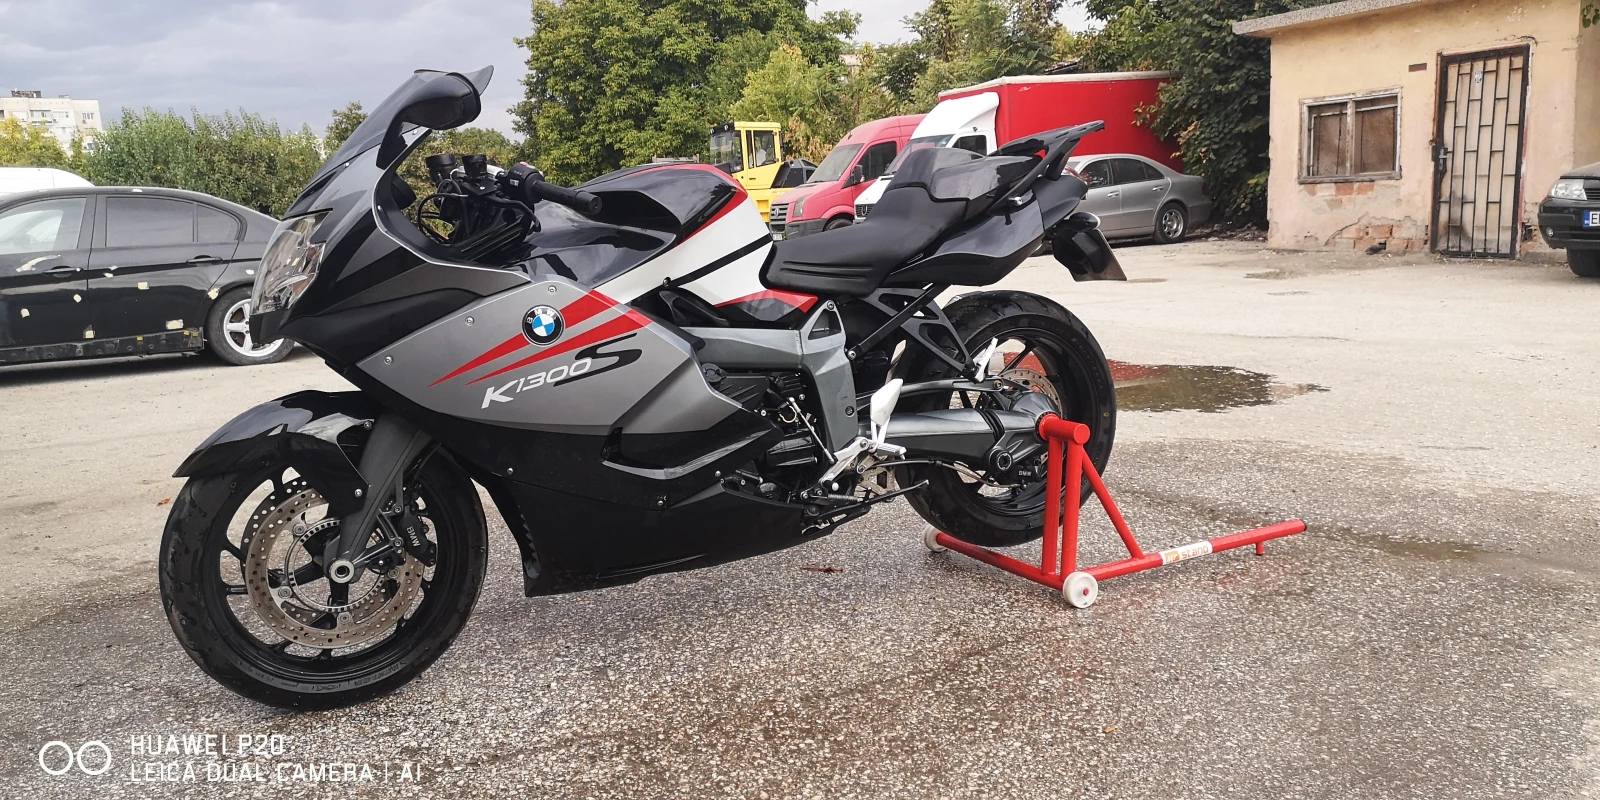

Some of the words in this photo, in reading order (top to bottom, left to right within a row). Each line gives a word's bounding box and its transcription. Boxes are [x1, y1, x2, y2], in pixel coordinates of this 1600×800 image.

[1591, 213, 1600, 225] E
[526, 308, 555, 324] BMW
[406, 526, 421, 547] BMW
